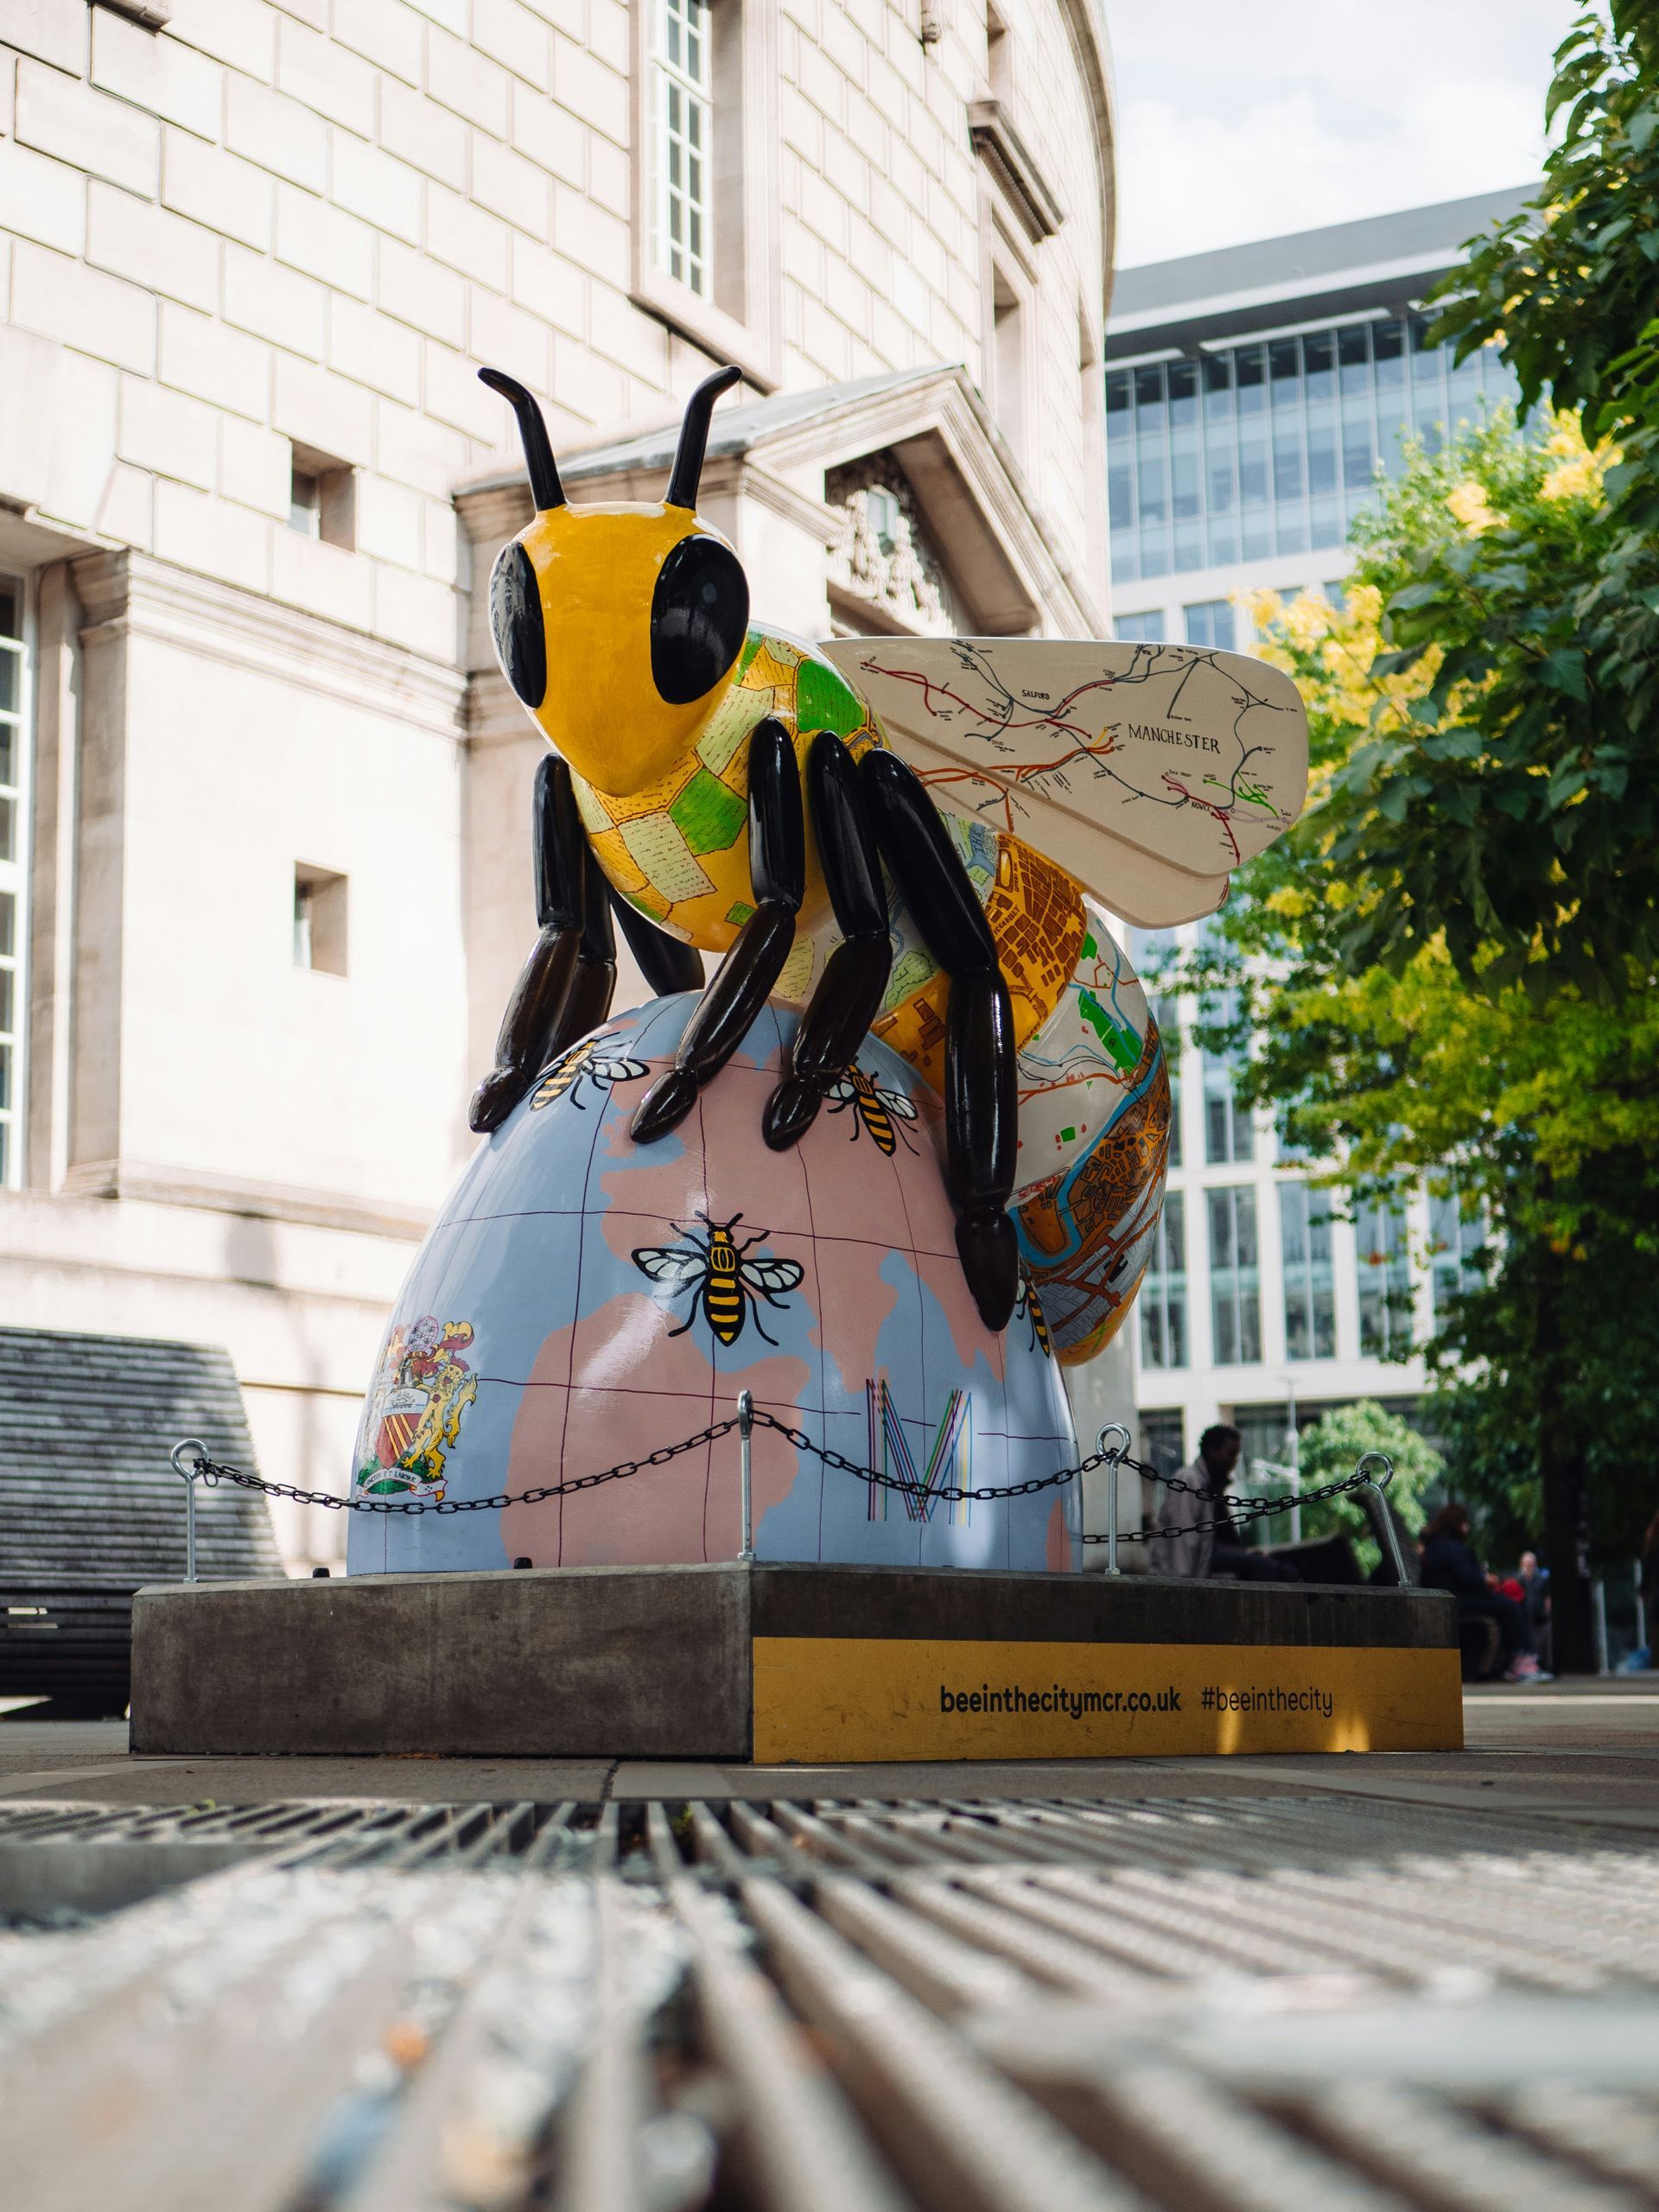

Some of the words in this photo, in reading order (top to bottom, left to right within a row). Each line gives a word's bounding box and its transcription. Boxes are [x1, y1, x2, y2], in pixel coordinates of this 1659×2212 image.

[1021, 689, 1051, 700] SALFORD
[1128, 723, 1221, 754] MANCHESTER
[1191, 801, 1210, 813] ARDWICK
[973, 830, 984, 854] THE
[993, 905, 1020, 936] ICCADILLY
[384, 1470, 393, 1478] ET
[394, 1470, 417, 1484] LABORE
[940, 1683, 1182, 1720] beeinthecitymcr.co.uk
[1201, 1686, 1333, 1718] #beeinthecity
